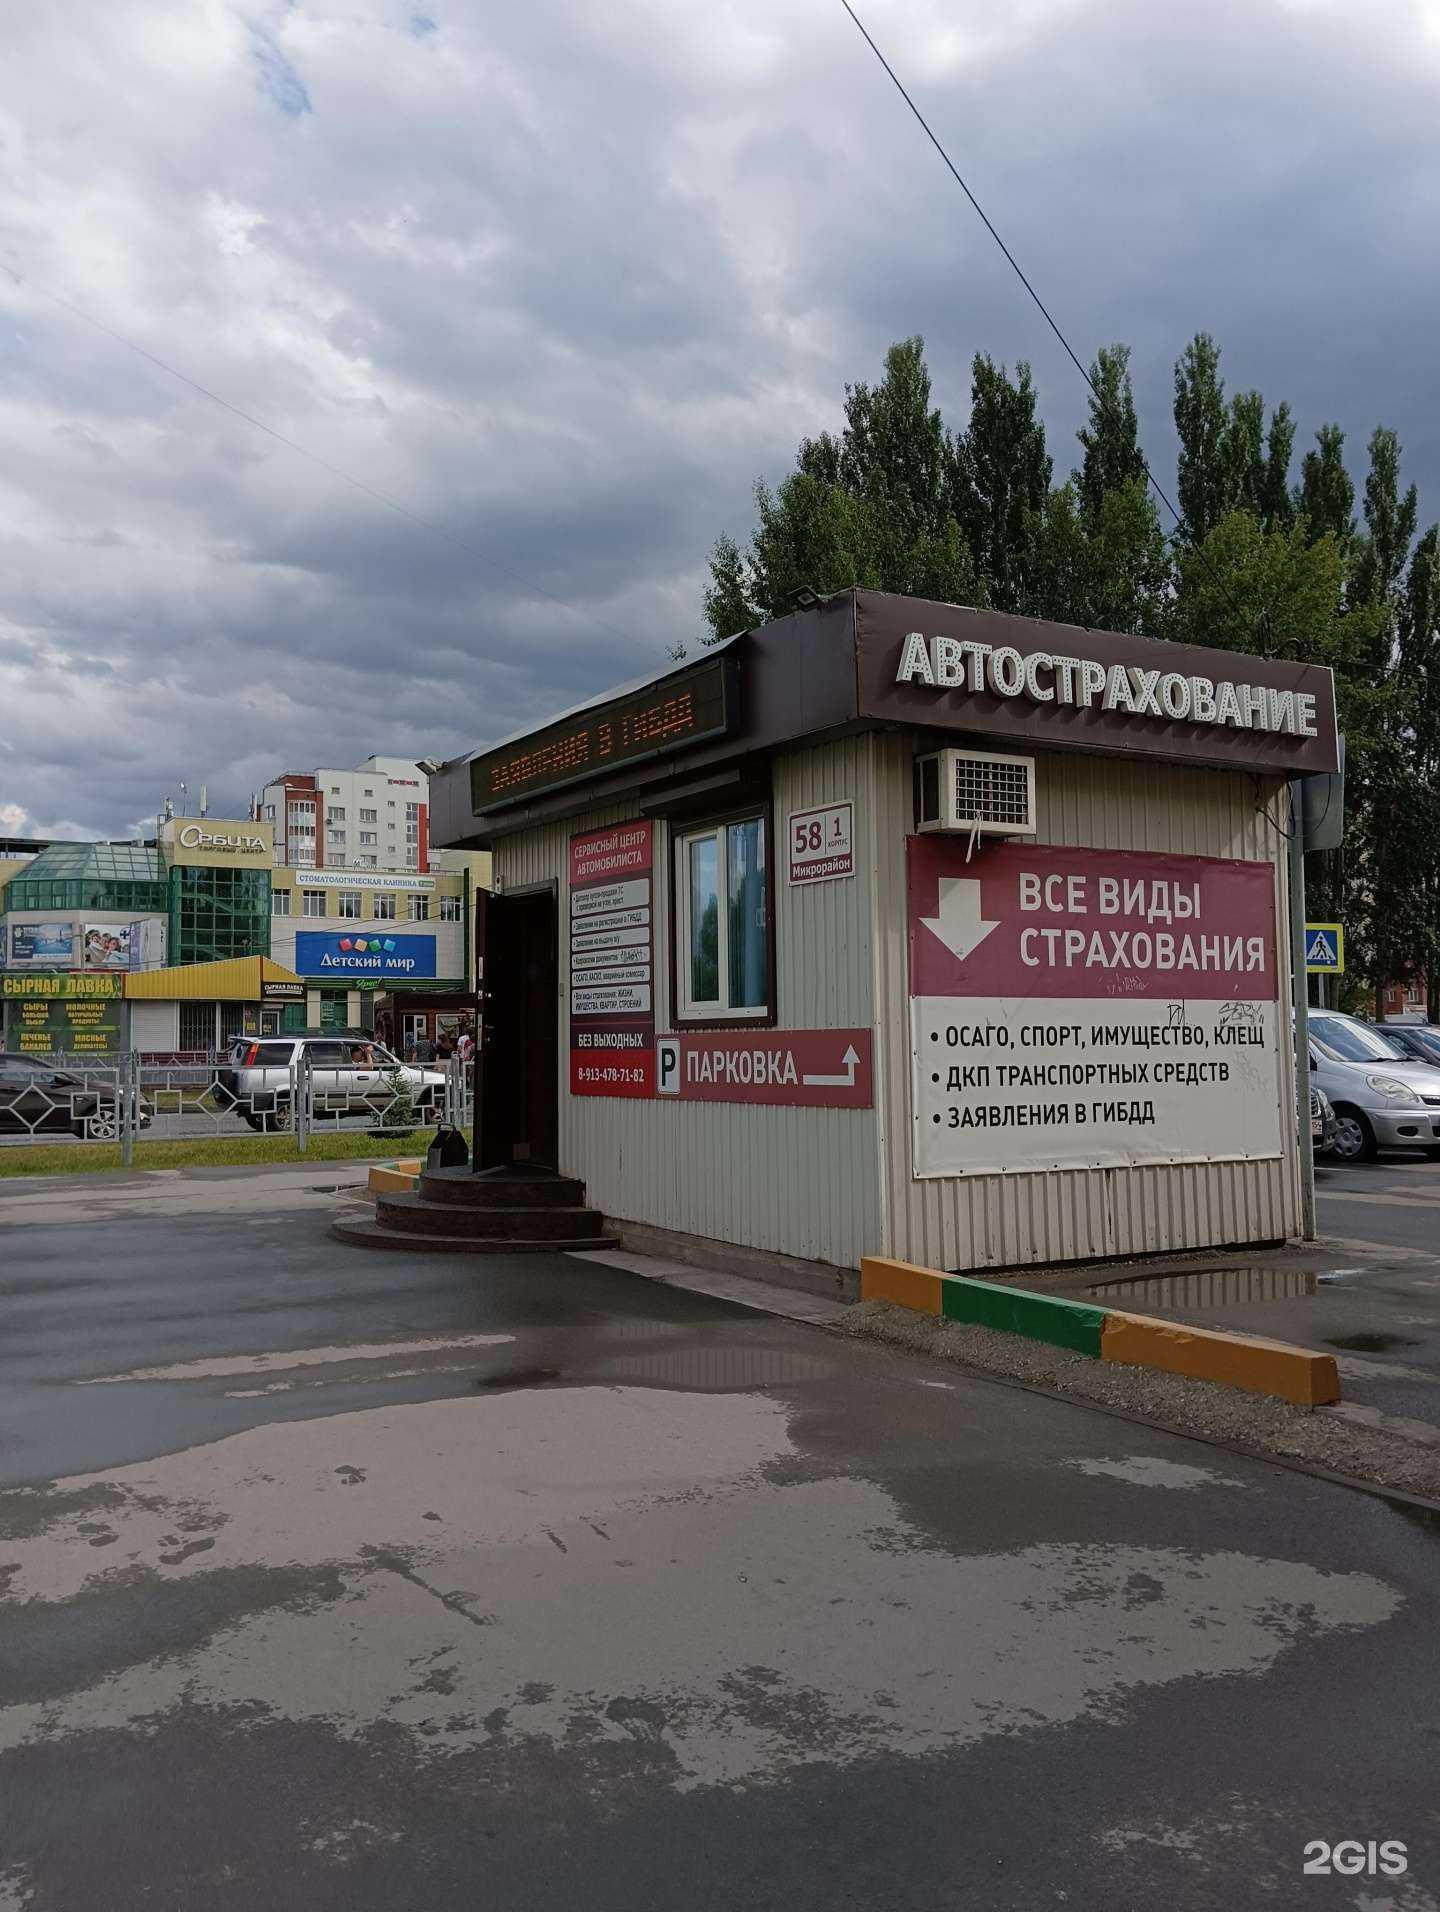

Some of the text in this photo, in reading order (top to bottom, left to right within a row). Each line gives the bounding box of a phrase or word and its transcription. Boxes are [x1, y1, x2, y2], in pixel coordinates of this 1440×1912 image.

[896, 632, 1318, 738] АВТОСТРАХОВАНИЕ
[795, 820, 822, 853] 58
[834, 816, 842, 837] 1
[574, 830, 646, 859] СЕРВИСНЫЙ ЦЕНТР
[577, 850, 642, 876] АВТОМОБИЛИСТА
[792, 857, 850, 878] Микрорайон
[299, 874, 382, 886] СТОМАТОЛОГИЧЕСКАЯ
[383, 879, 417, 888] КЛИНИКА
[1018, 872, 1201, 926] ВСЕ ВИДЫ
[320, 953, 416, 972] Детский мир
[1019, 927, 1265, 973] СТРАХОВАНИЯ
[3, 978, 114, 993] СЫРНАЯ ЛАВКА
[23, 1003, 48, 1011] СЫРЫ
[578, 1032, 643, 1050] БЕЗ ВЫХОДНЫХ
[945, 1025, 1265, 1050] ОСАГО, СПОРТ, ИМУЩЕСТВО, КЛЕЩ
[578, 1067, 645, 1083] 8-913-478-71-82
[660, 1047, 676, 1087] P
[687, 1050, 799, 1085] ПАРКОВКА
[946, 1062, 1230, 1091] ДКП ТРАНСПОРТНЫХ СРЕДСТВ
[947, 1100, 1155, 1129] ЗАЯВЛЕНИЯ В ГИБДД
